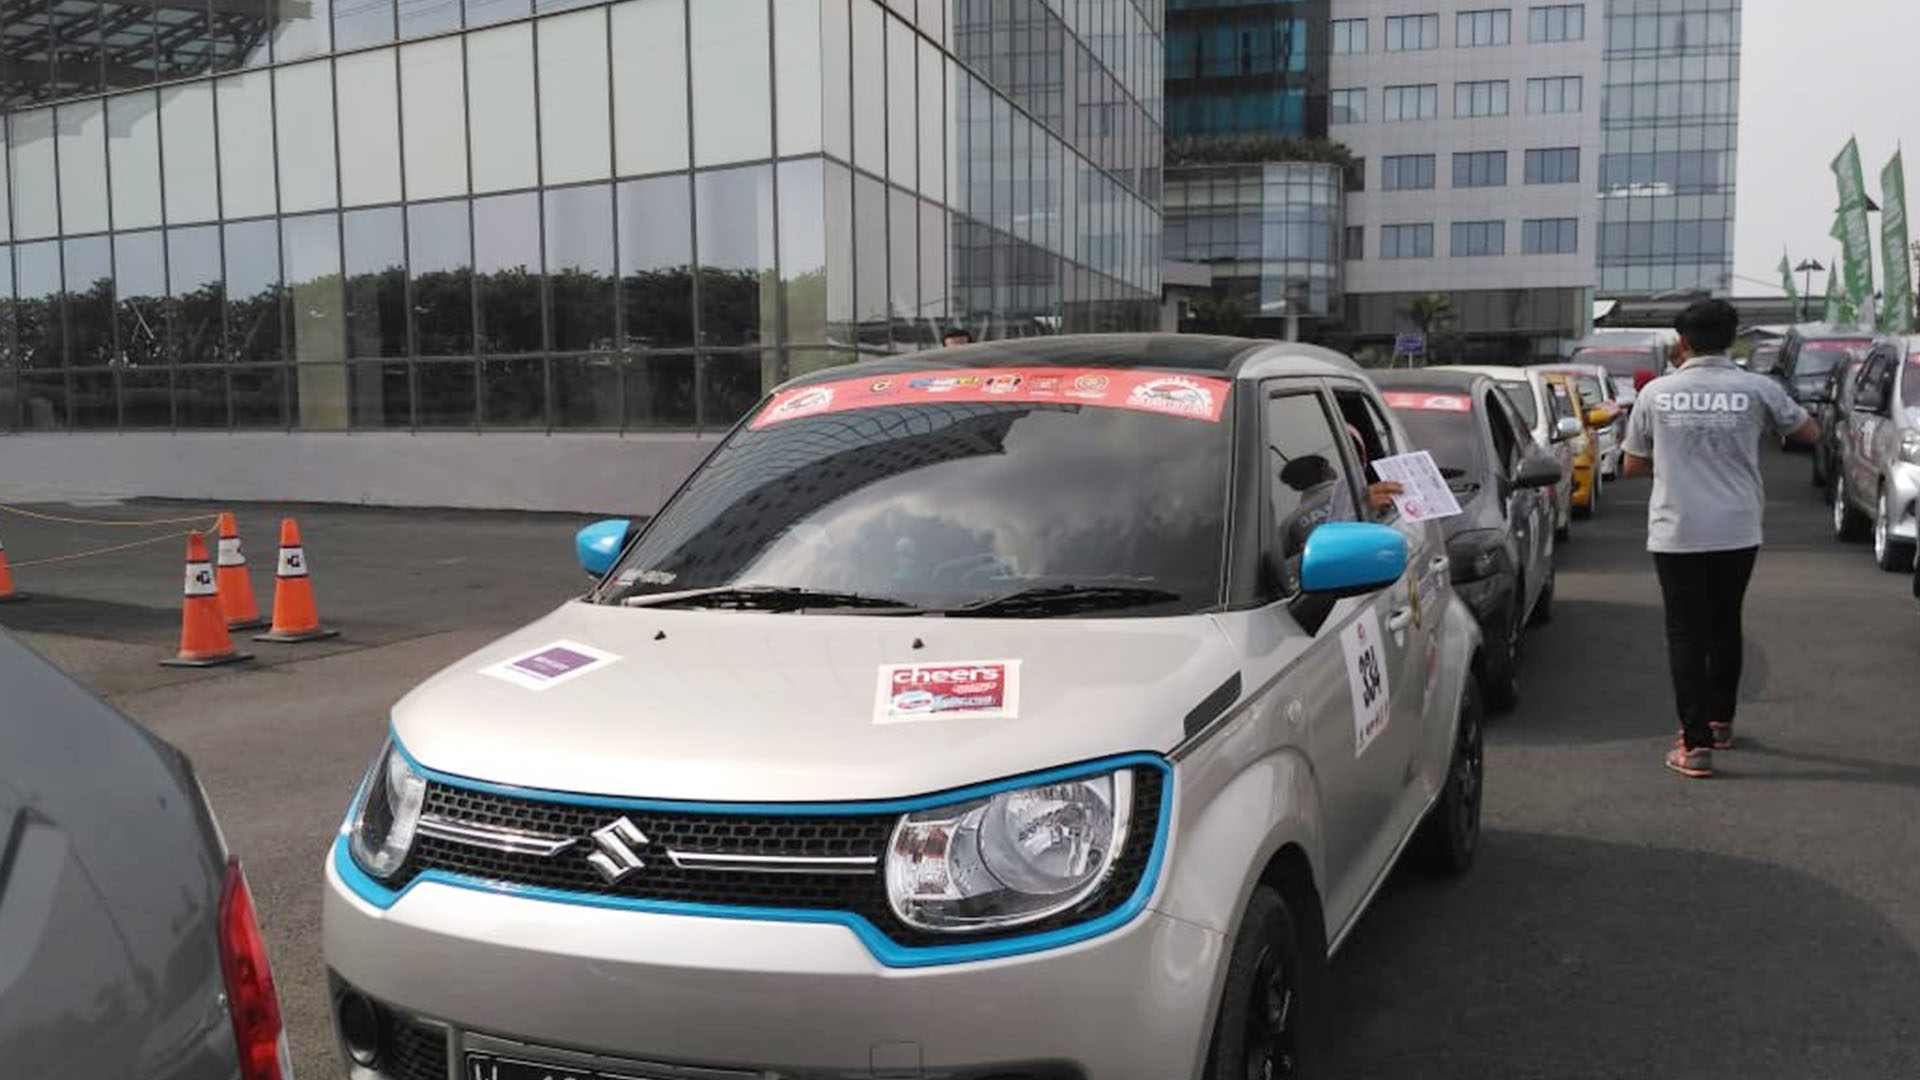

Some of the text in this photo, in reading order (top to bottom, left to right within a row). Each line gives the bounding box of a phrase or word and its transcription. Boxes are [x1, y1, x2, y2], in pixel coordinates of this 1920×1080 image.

[1655, 392, 1749, 412] SQUAD
[893, 666, 999, 683] cheers
[1358, 645, 1382, 709] 334
